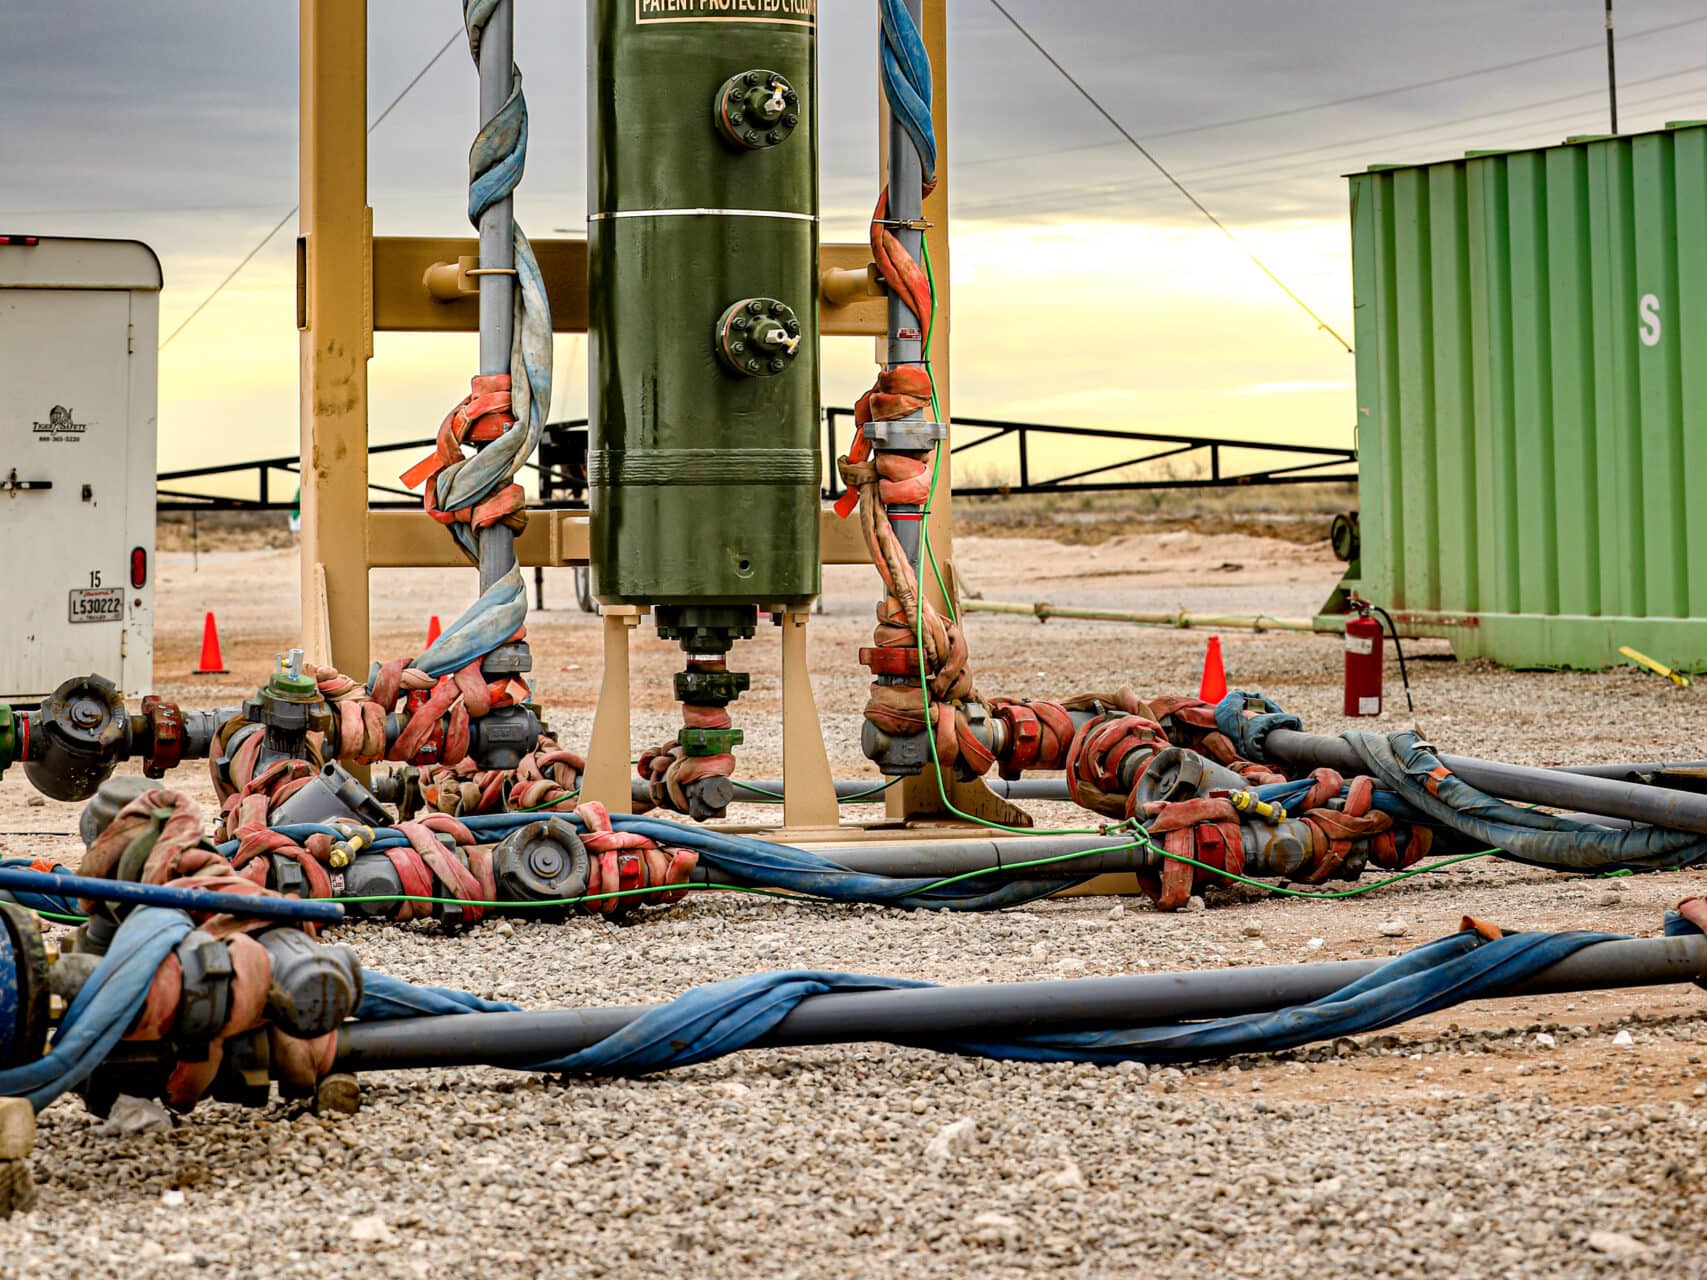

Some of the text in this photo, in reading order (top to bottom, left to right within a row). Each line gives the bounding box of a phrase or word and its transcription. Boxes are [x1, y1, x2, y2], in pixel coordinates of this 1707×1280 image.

[1639, 293, 1661, 346] S
[89, 570, 102, 588] 15
[72, 597, 120, 615] L530222
